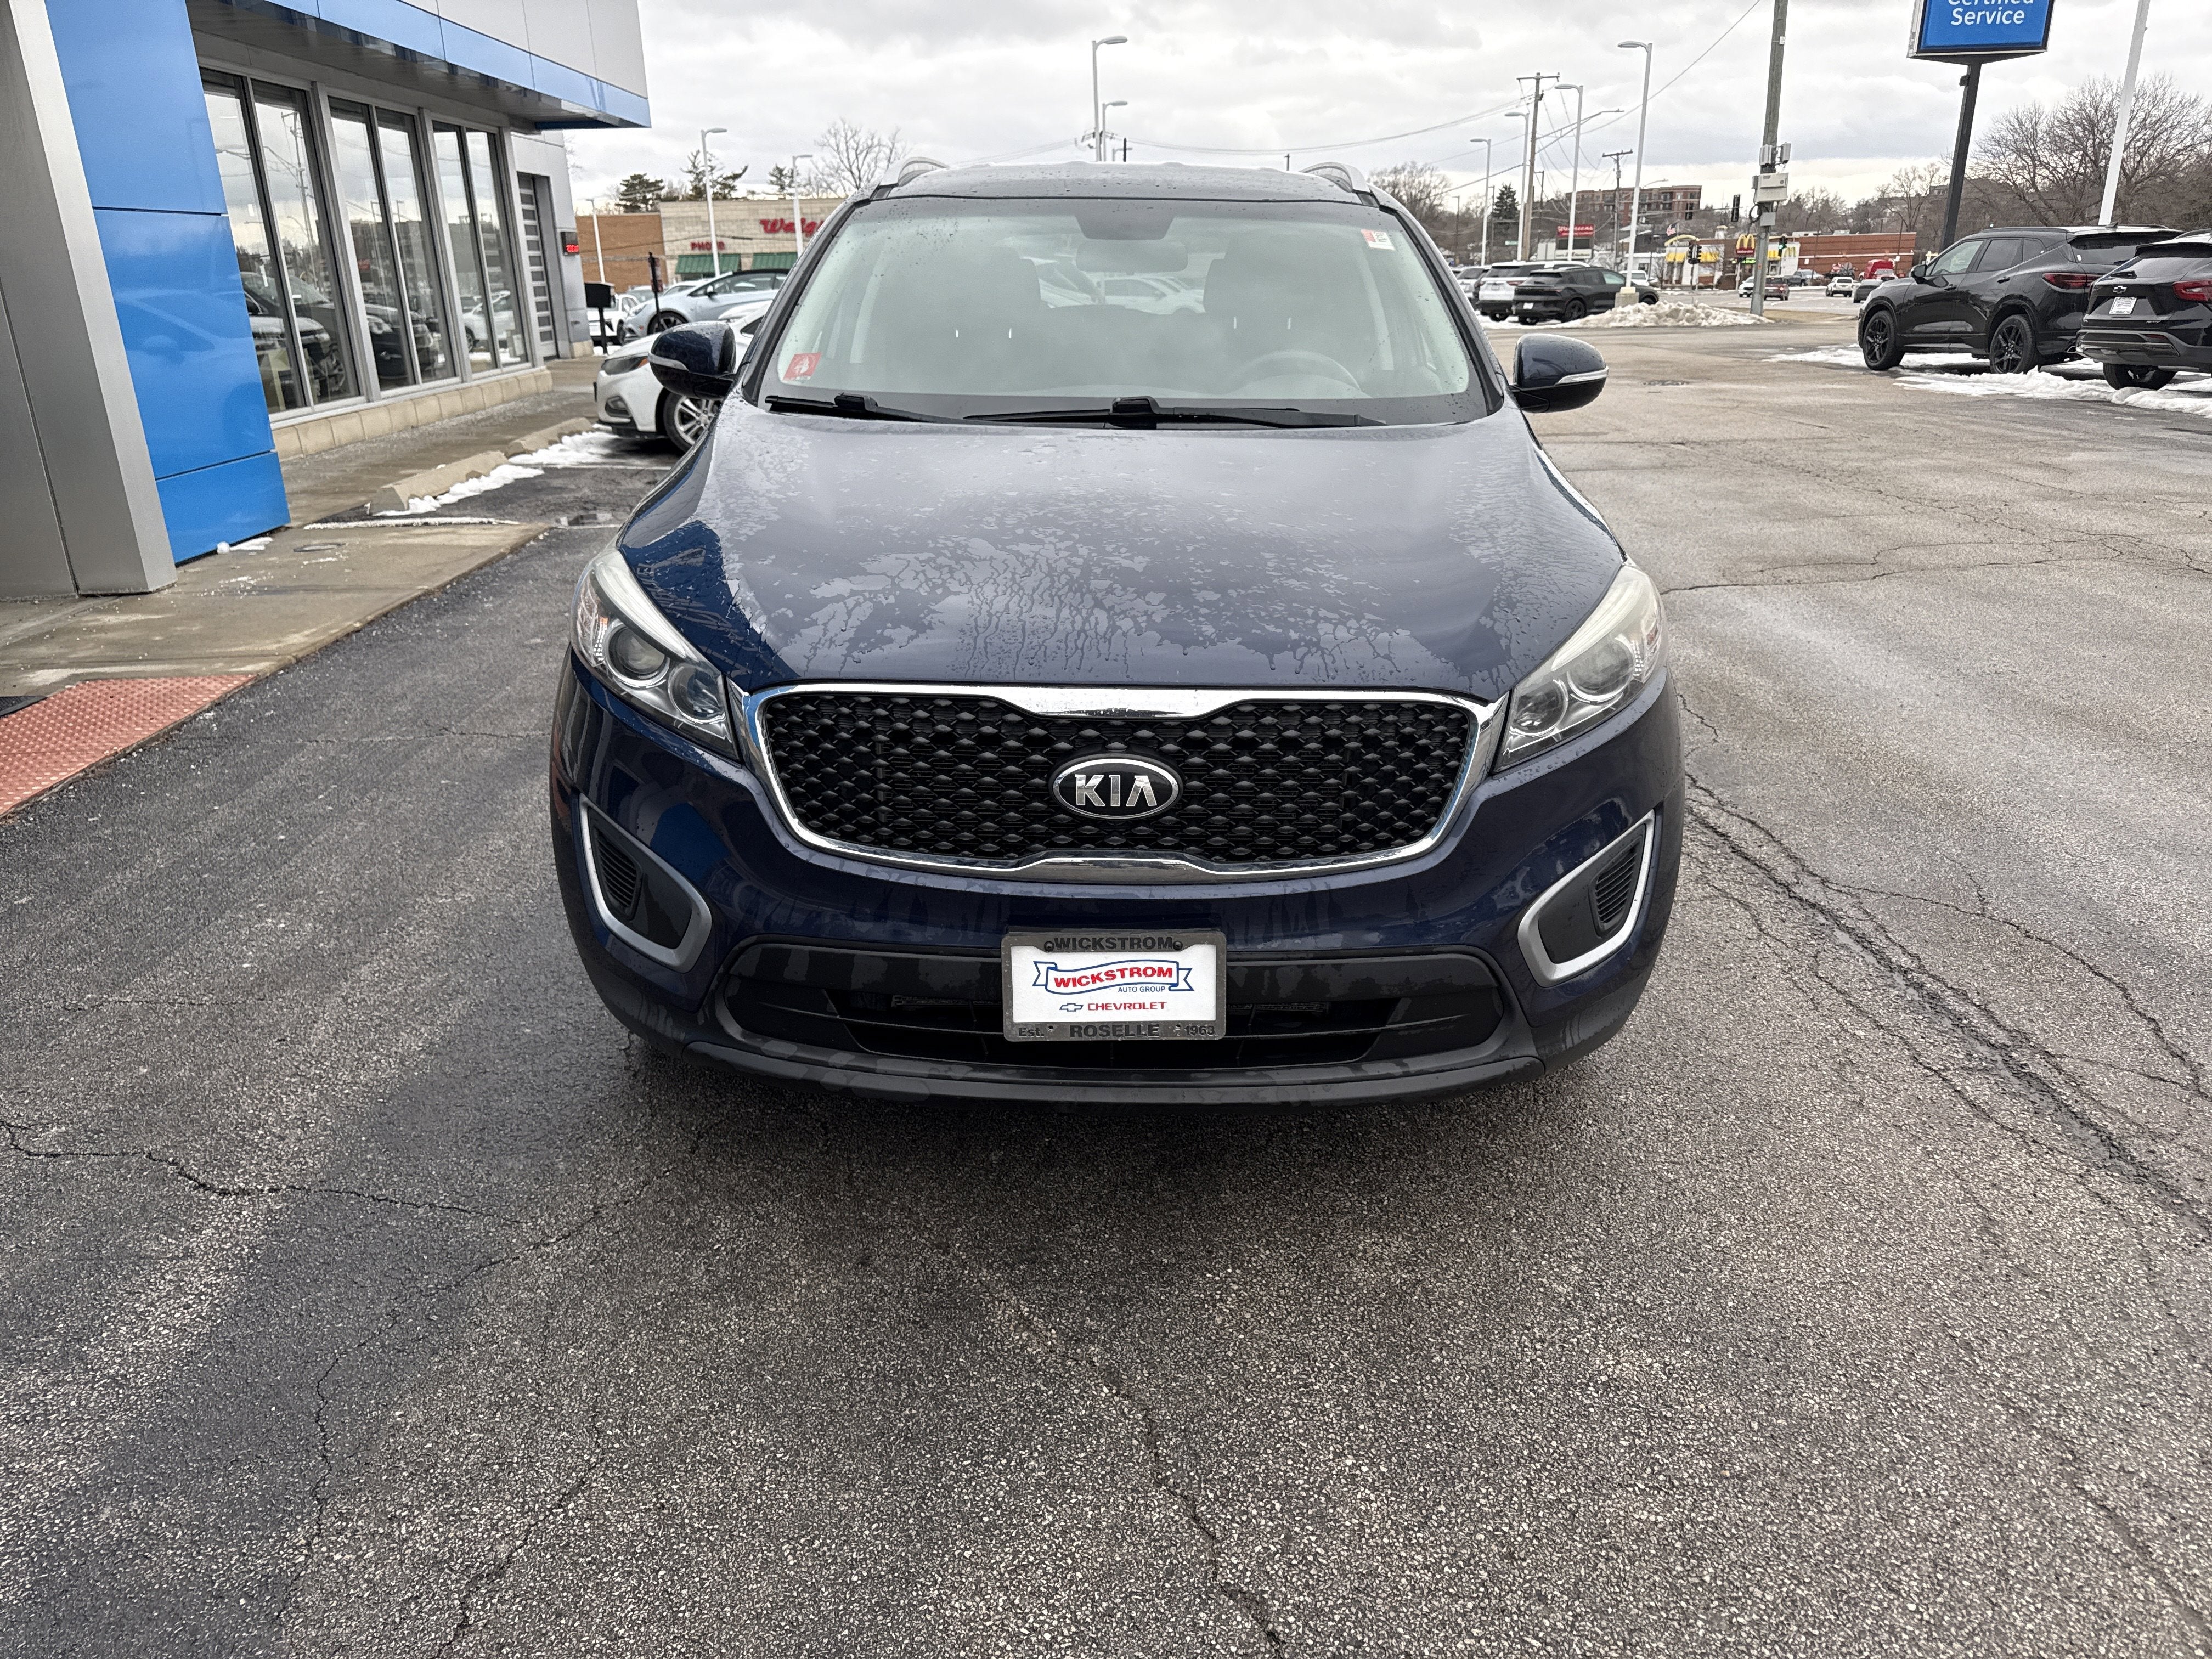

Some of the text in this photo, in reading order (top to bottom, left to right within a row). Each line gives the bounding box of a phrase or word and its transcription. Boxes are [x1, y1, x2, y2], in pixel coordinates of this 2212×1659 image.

[1950, 7, 2025, 25] Service
[1075, 774, 1157, 807] KIA
[1053, 937, 1173, 951] WICKSTROM
[1054, 967, 1173, 988] WICKSTROM
[1087, 1002, 1167, 1011] CHEVROLET
[1018, 1024, 1215, 1038] Est. ROSELLE 1963
